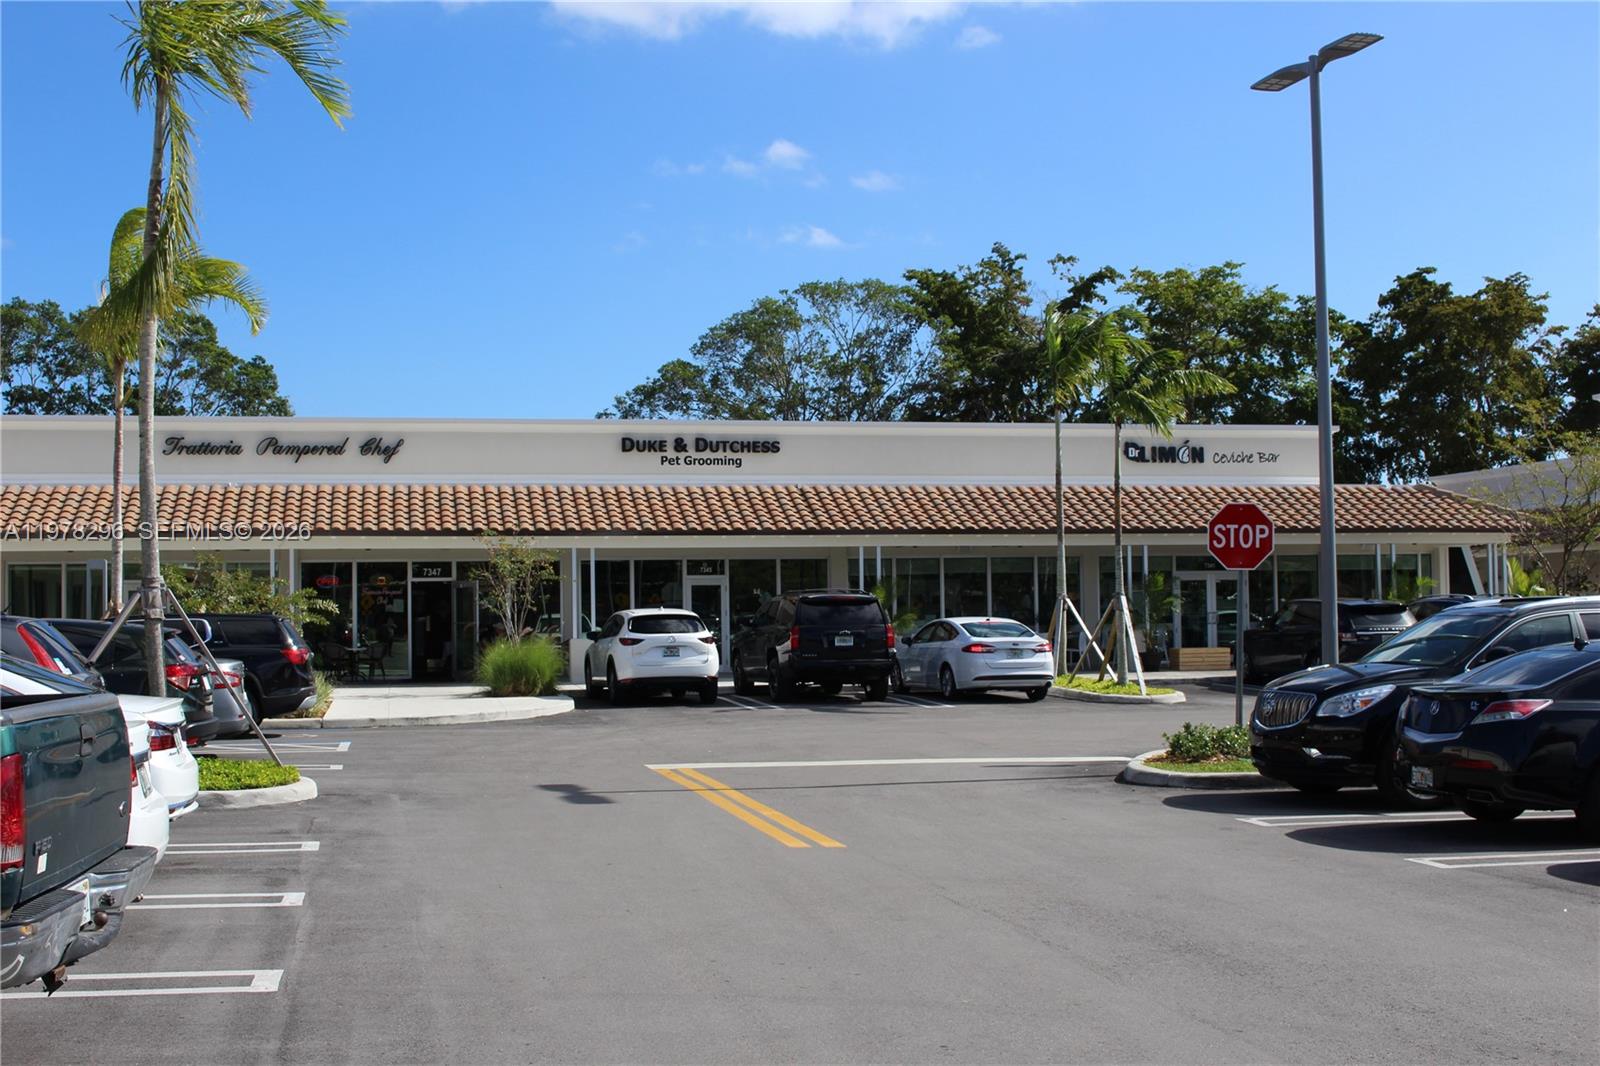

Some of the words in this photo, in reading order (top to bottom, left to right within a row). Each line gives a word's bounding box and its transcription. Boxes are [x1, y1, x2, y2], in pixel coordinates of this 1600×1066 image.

[162, 437, 244, 456] Trattoria
[256, 437, 349, 463] Pampered
[359, 437, 404, 464] Chef
[621, 437, 668, 453] DUKE
[673, 437, 688, 453] &
[694, 437, 781, 453] DUTCHESS
[660, 456, 681, 466] Pet
[684, 455, 742, 468] Grooming
[1212, 451, 1254, 464] Ceviche
[1257, 451, 1280, 463] Bar
[1212, 524, 1270, 549] STOP
[423, 567, 442, 576] 7347
